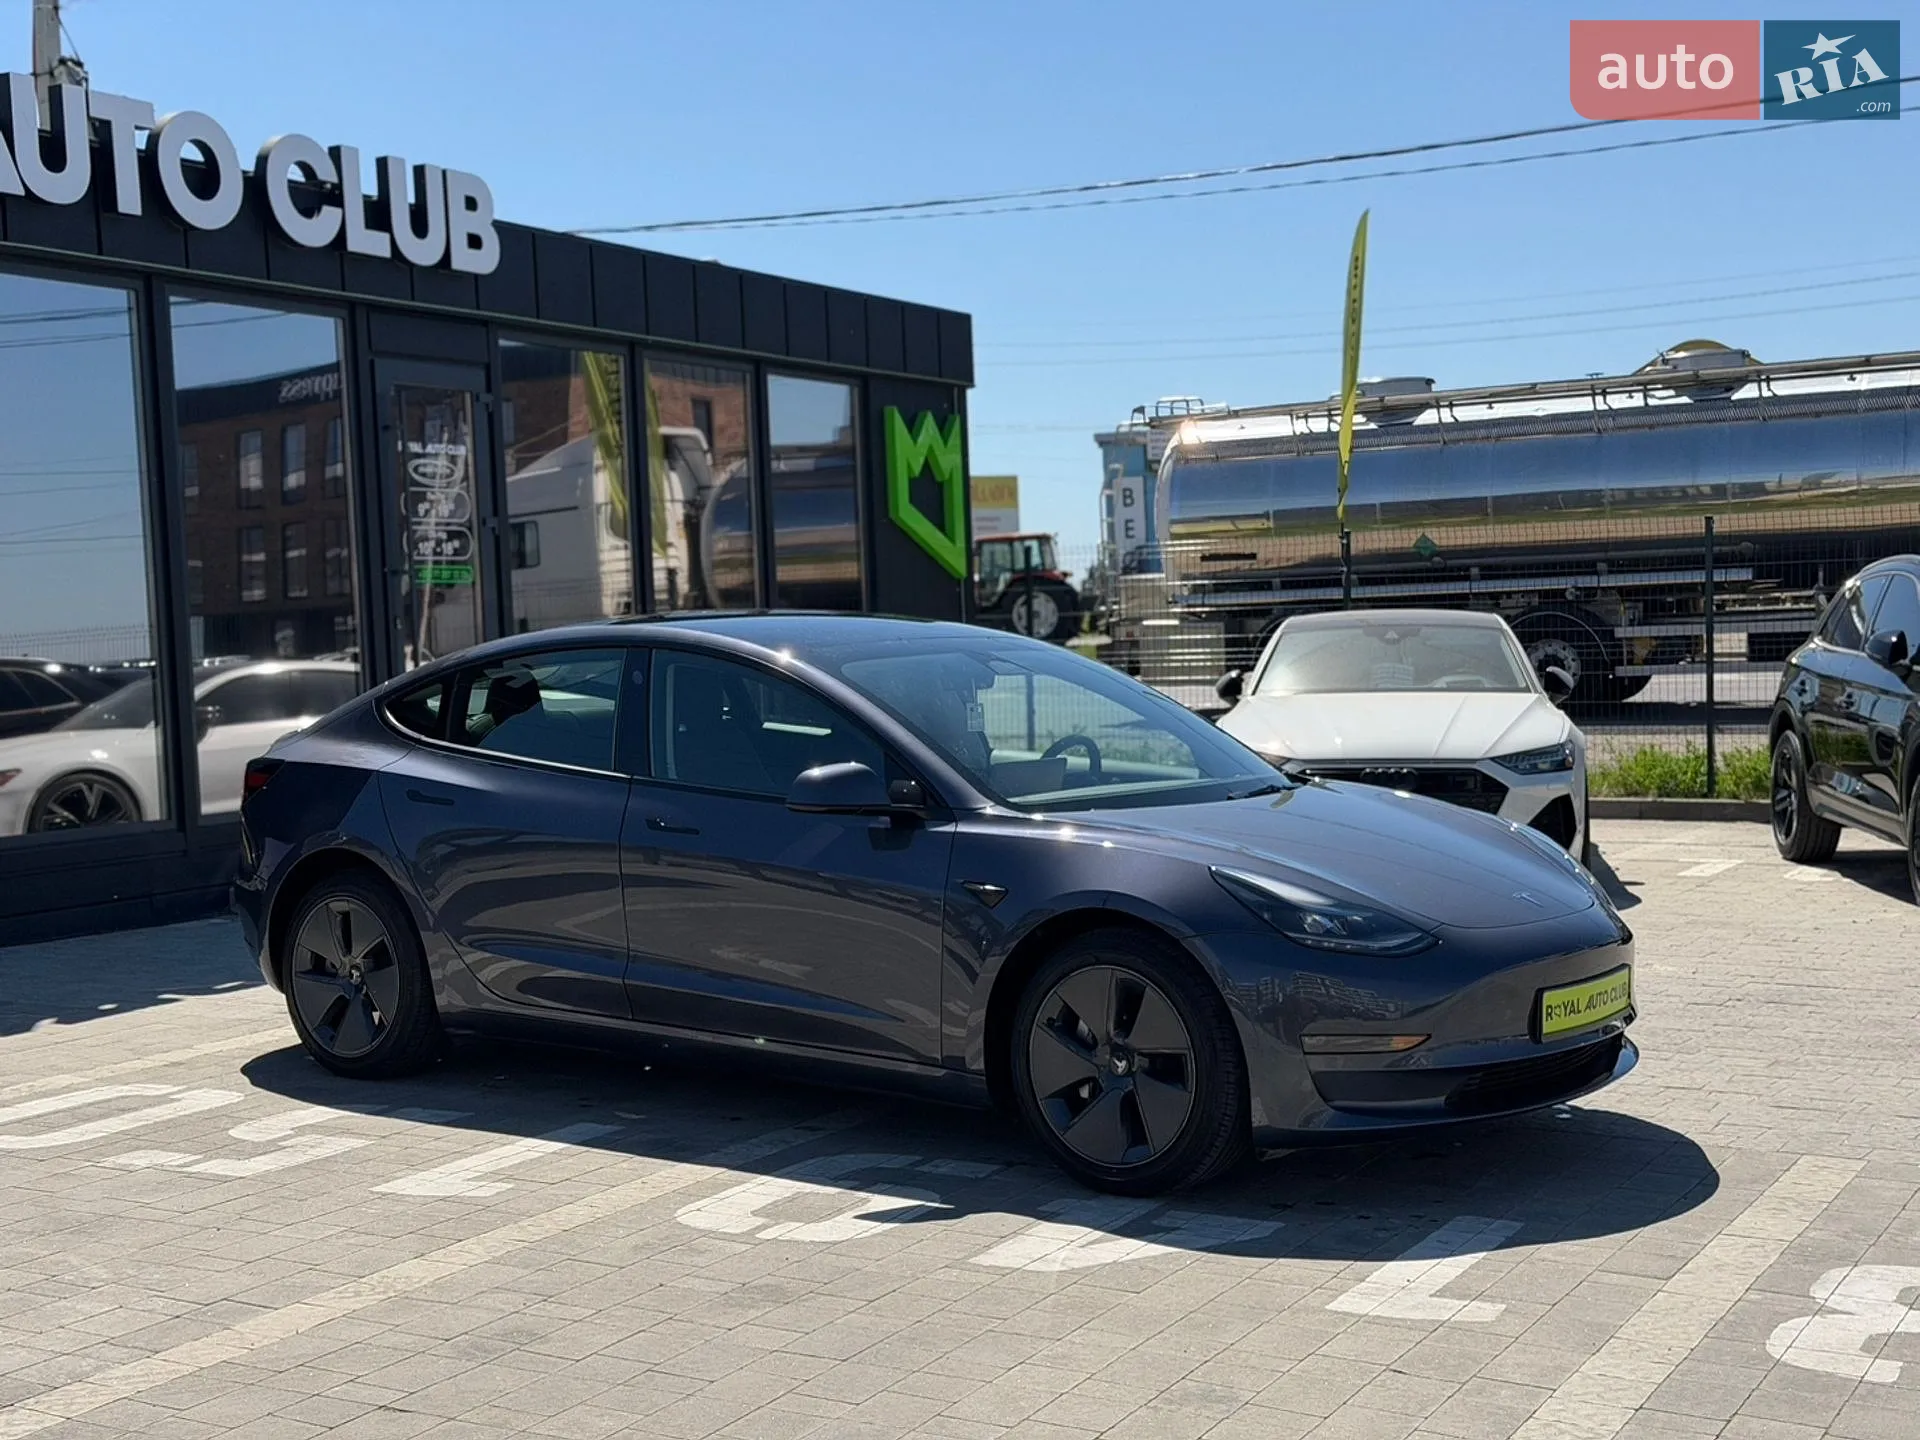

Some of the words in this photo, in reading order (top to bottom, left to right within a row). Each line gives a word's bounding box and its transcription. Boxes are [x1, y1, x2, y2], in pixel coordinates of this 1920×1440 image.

[256, 133, 500, 275] CLUB
[1583, 990, 1610, 1012] AUTO
[1609, 981, 1628, 1004] CLUB
